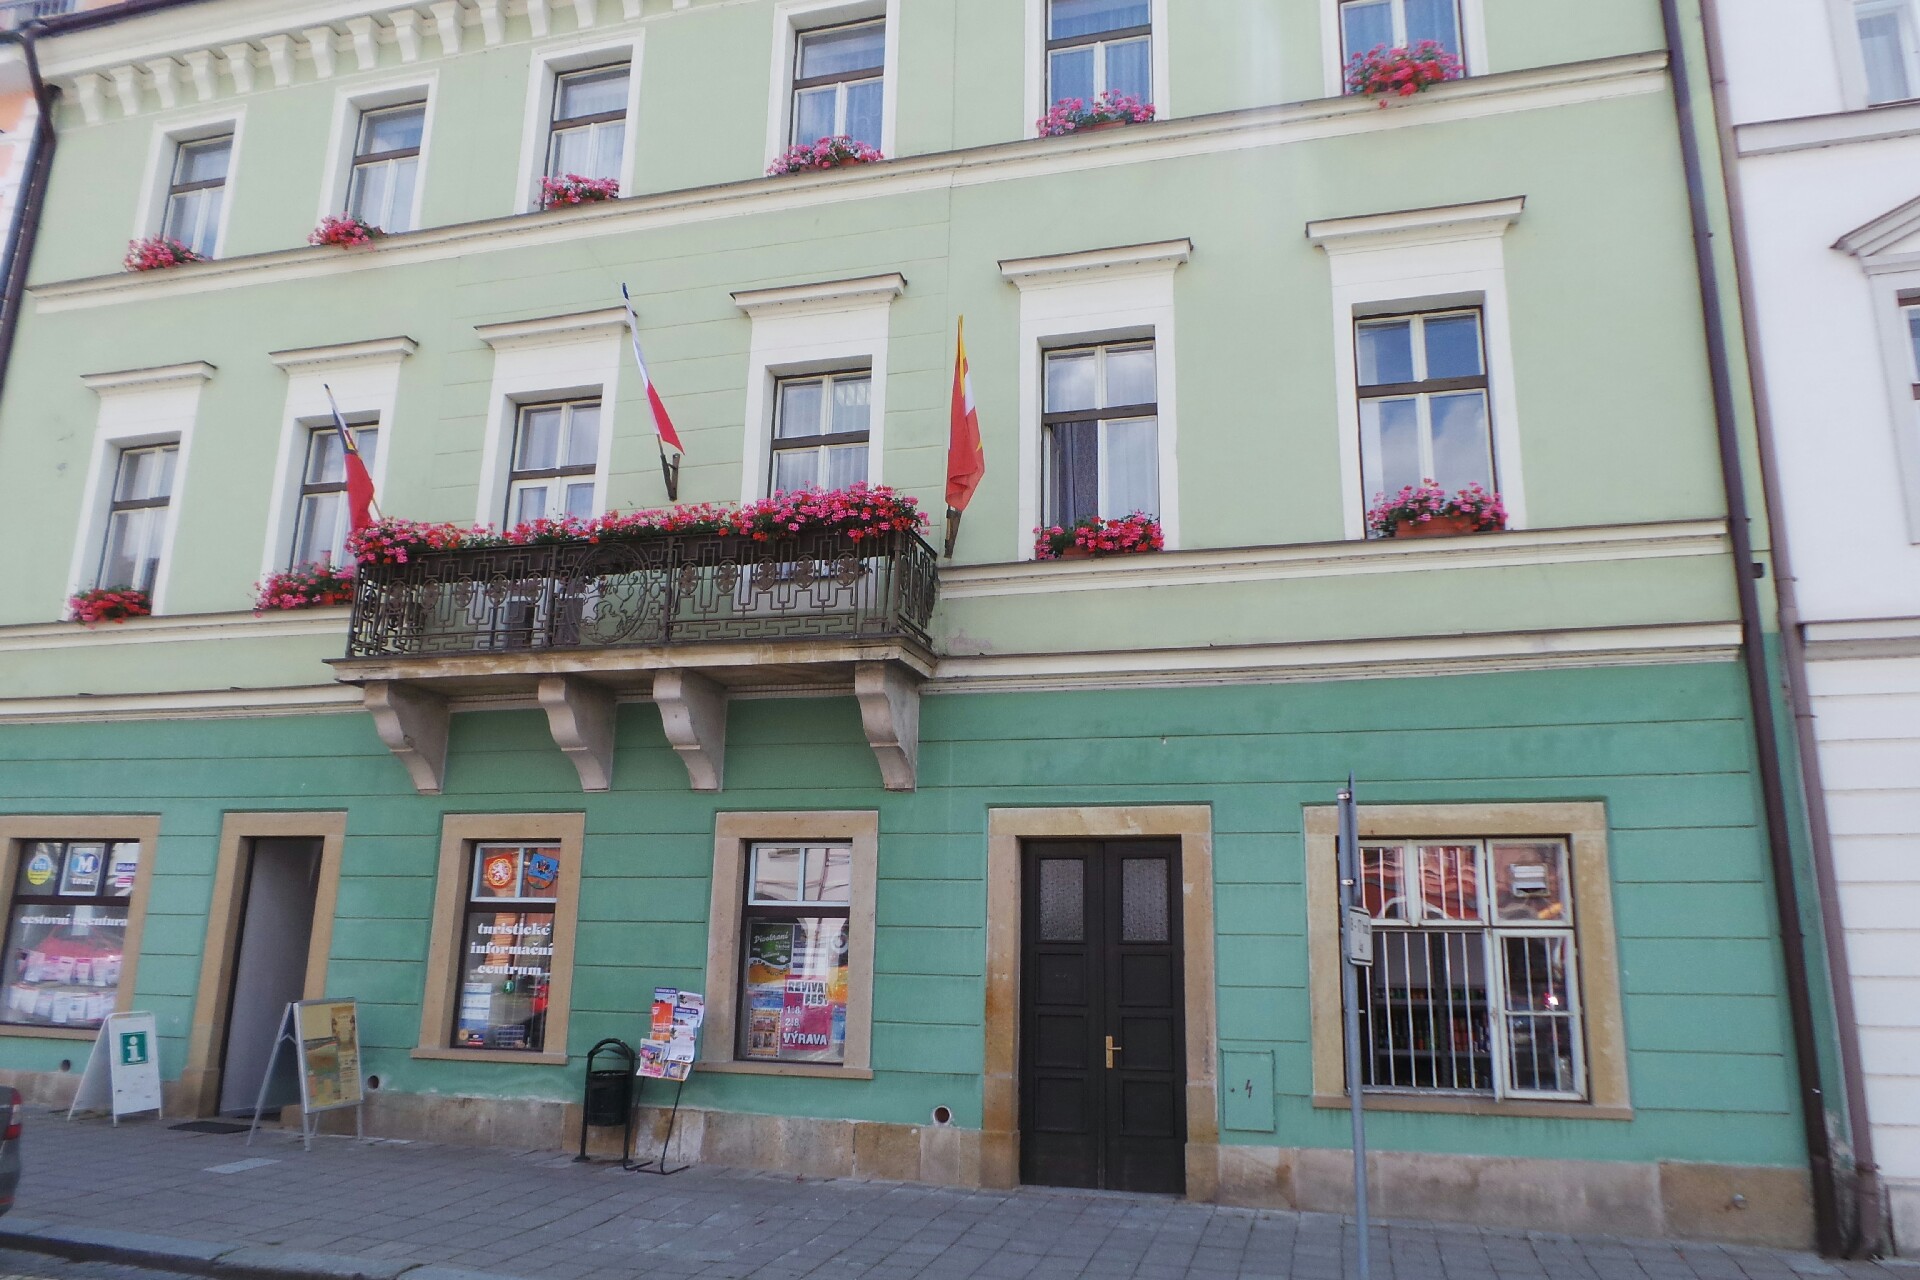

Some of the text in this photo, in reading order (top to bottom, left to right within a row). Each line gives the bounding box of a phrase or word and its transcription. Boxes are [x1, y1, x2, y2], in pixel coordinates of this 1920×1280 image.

[77, 855, 95, 873] M
[21, 913, 70, 925] cestovní
[477, 922, 551, 936] turistické
[470, 941, 553, 955] informační
[477, 962, 542, 976] centrum
[783, 1031, 828, 1045] VÝRAVA
